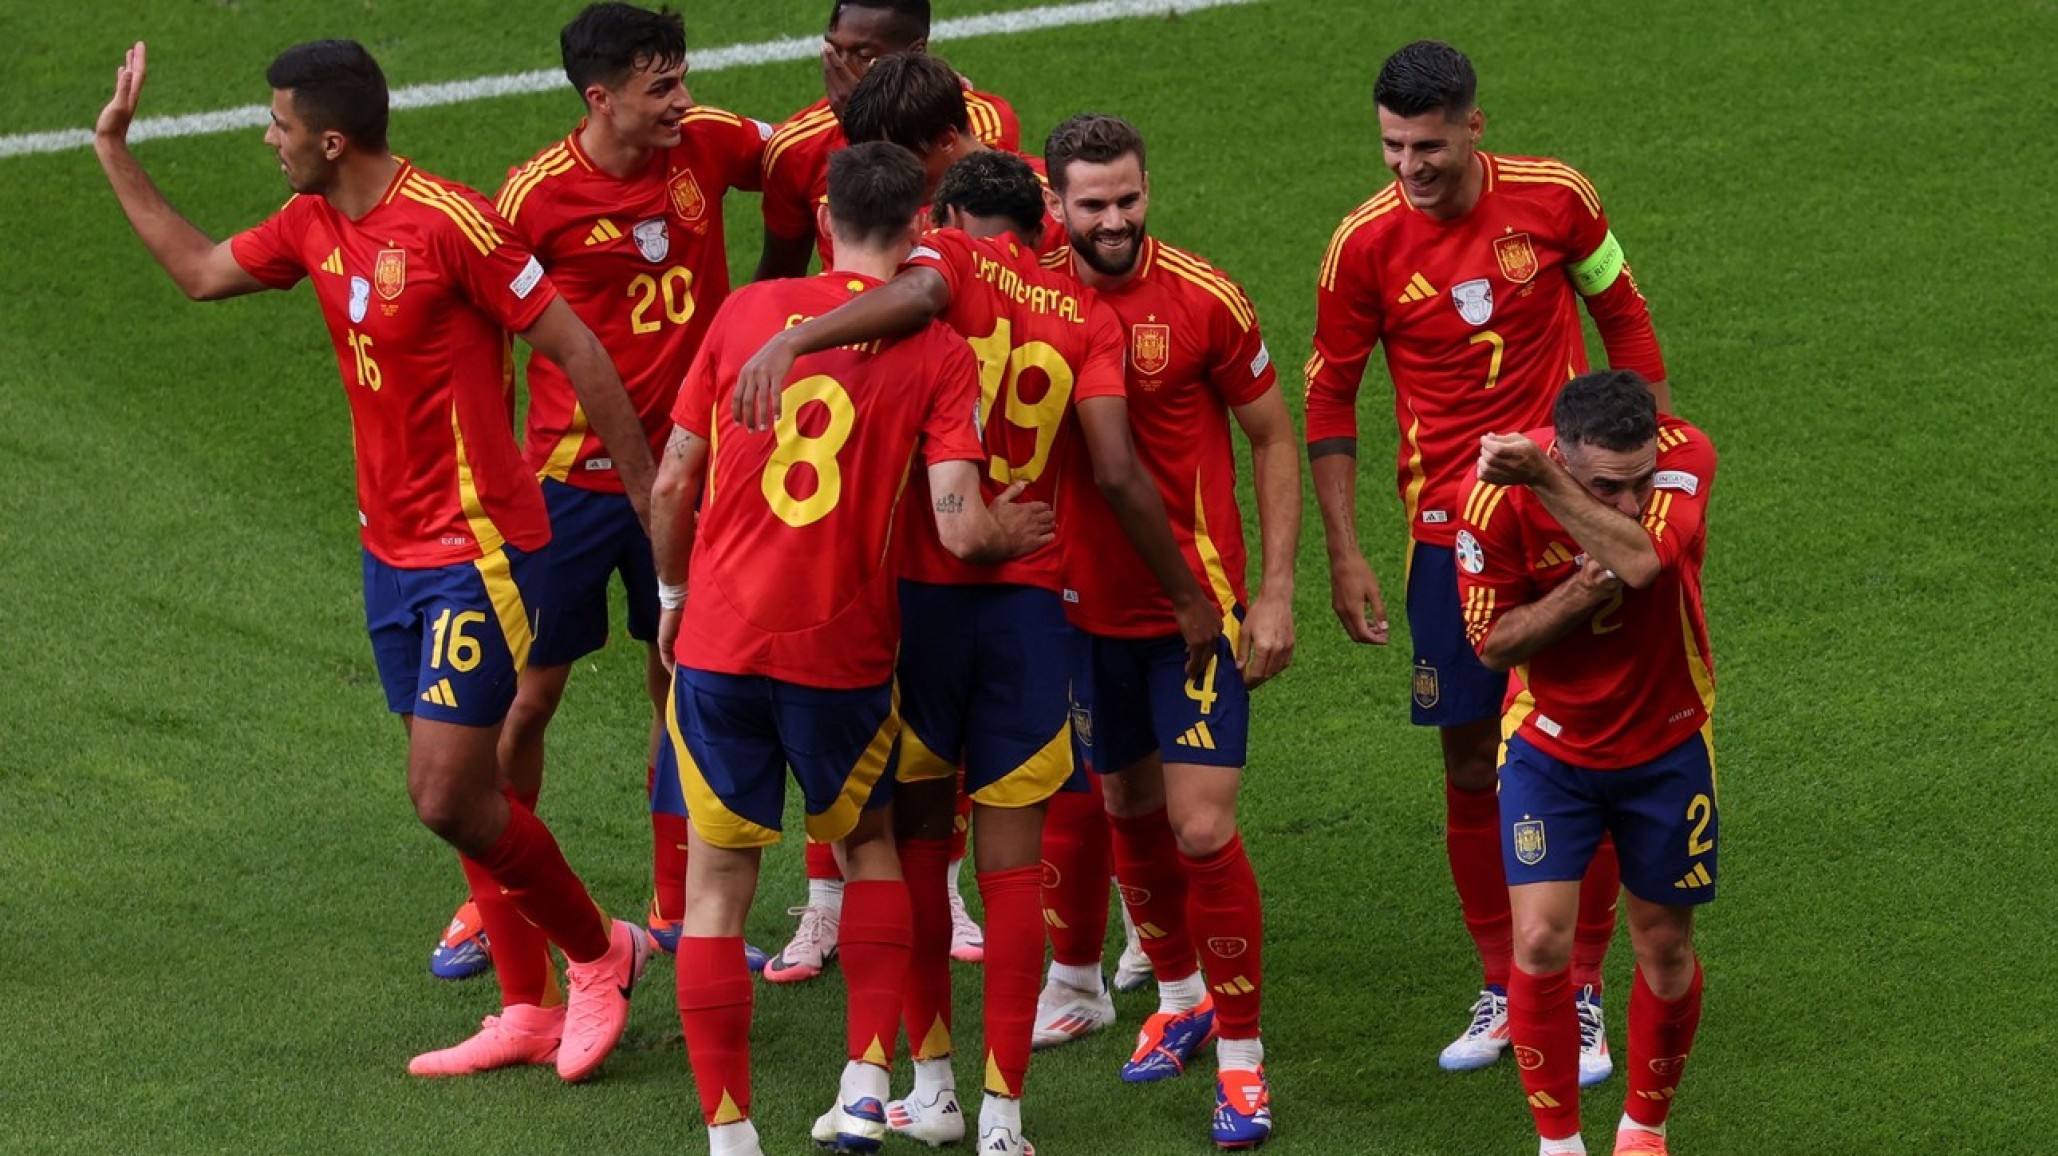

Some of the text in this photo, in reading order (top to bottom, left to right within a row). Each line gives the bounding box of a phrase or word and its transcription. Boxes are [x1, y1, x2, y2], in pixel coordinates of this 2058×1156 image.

[626, 265, 695, 335] 20
[347, 328, 382, 392] 16
[1469, 330, 1504, 389] 7
[967, 317, 1074, 485] 19
[761, 374, 855, 528] 8
[1591, 580, 1624, 635] 2
[430, 607, 486, 673] 16
[1184, 653, 1218, 715] 4
[1686, 793, 1713, 857] 2
